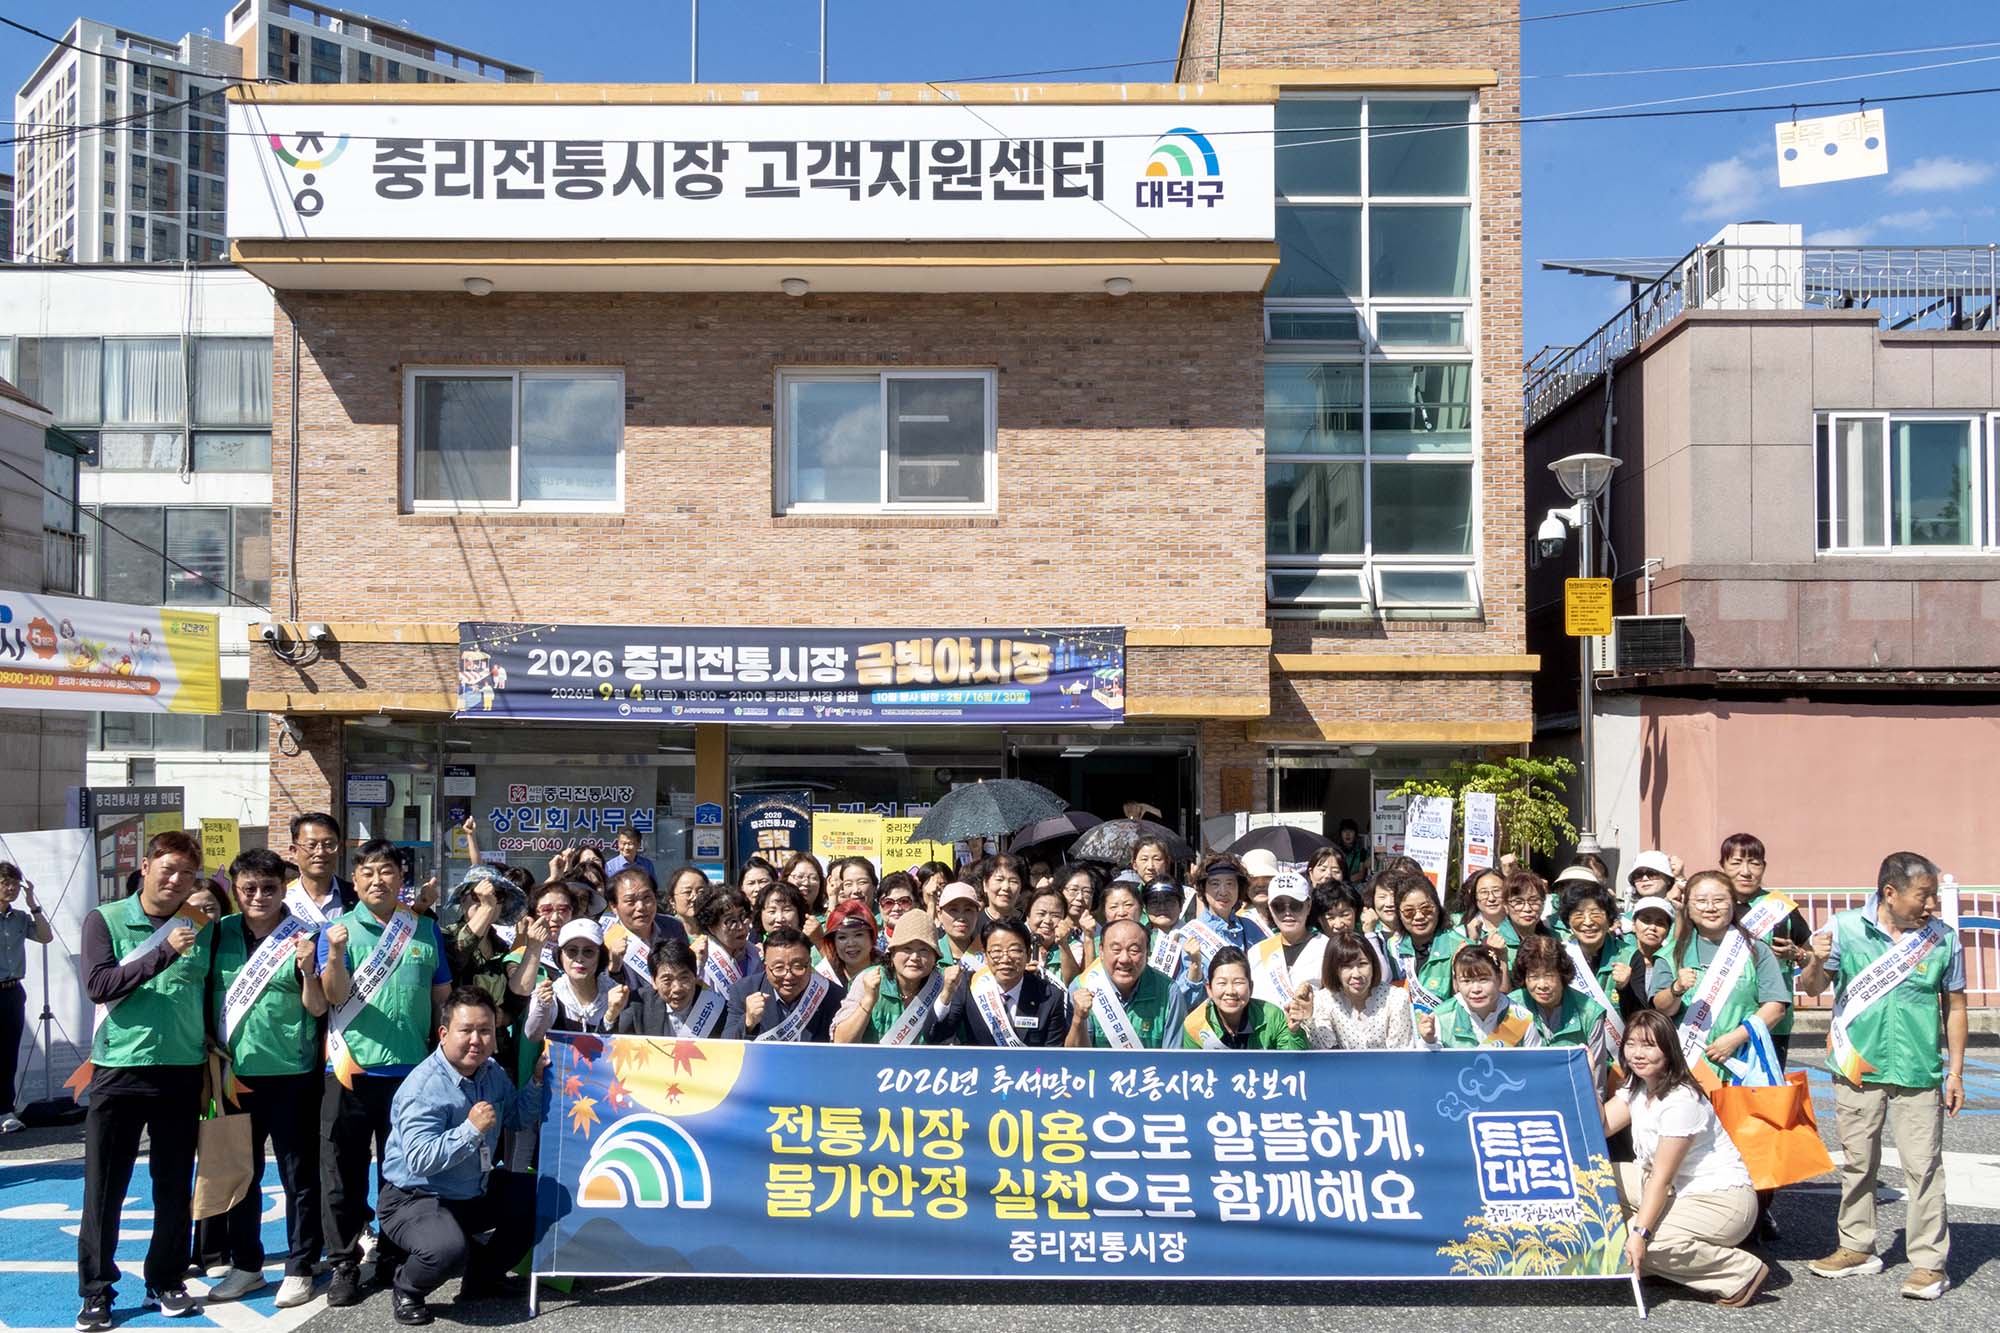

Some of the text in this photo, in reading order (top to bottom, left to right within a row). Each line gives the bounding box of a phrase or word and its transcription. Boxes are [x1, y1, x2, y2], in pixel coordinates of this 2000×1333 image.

[373, 139, 1104, 200] 중리전통시장 고객지원센터
[1136, 180, 1224, 208] 대덕구
[527, 648, 614, 678] 2026
[622, 645, 848, 682] 중리전통시장
[551, 687, 594, 699] 2026년
[599, 683, 625, 700] 9월
[629, 683, 678, 701] 4일(금)
[683, 690, 716, 701] 18:00
[729, 690, 762, 702] 21:00
[765, 690, 832, 702] 중리전통시장
[96, 793, 140, 807] 중리전통시장
[543, 785, 633, 802] 중리전통시장
[701, 813, 716, 823] 26
[499, 838, 563, 851] 623-1040
[886, 847, 922, 857] 채널 오픈
[266, 918, 298, 951] 지역물가
[382, 918, 403, 950] 지역물가
[1728, 934, 1745, 957] 비자의
[1899, 925, 1933, 957] 지역물가
[362, 948, 386, 976] 안정에
[1871, 952, 1900, 977] 안정에
[877, 1066, 1308, 1102] 2026년 추석맞이 전통시장 장보기
[765, 1105, 1425, 1164] 전통시장 이용으로 알뜰하게,
[1477, 1120, 1562, 1157] 든든
[764, 1163, 1423, 1223] 물가안정 실천으로 함께해요
[1483, 1159, 1570, 1195] 대덕
[1009, 1230, 1187, 1263] 중리전통시장
